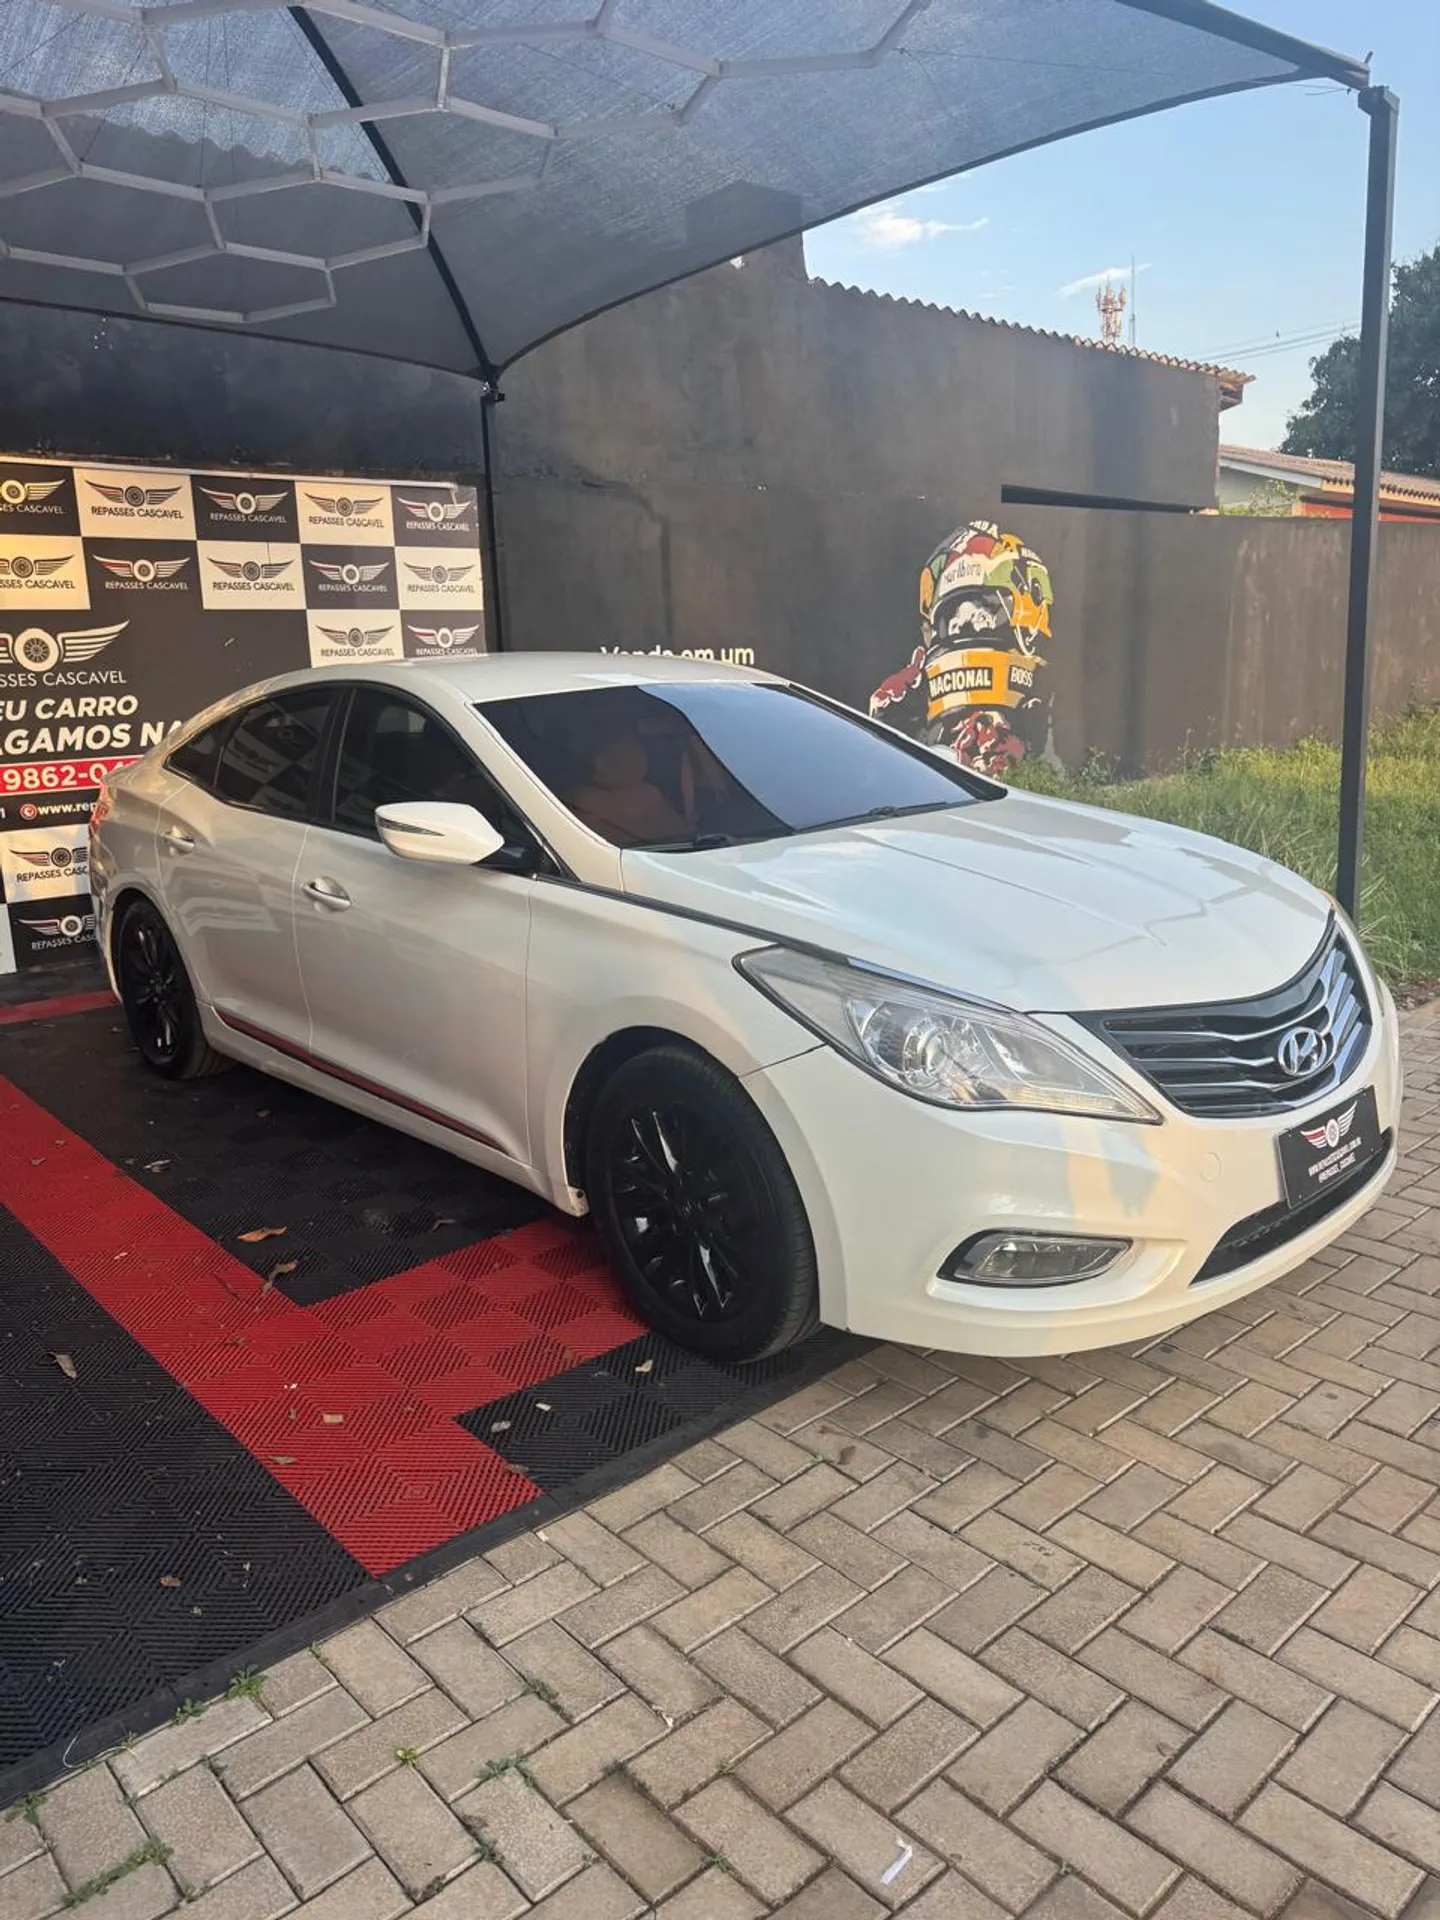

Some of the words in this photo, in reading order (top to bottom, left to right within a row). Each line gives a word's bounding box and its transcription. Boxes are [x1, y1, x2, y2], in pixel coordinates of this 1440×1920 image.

[16, 504, 66, 515] CASCAVEL
[91, 506, 135, 517] REPASSES
[137, 508, 184, 520] CASCAVEL
[209, 512, 246, 522] REPASSES
[247, 513, 288, 524] CASCAVEL
[308, 515, 345, 526] REPASSES
[346, 517, 385, 528] CASCAVEL
[25, 579, 76, 590] CASCAVEL
[105, 581, 145, 590] REPASSES
[146, 581, 189, 591] CASCAVEL
[212, 581, 252, 591] REPASSES
[253, 581, 295, 591] CASCAVEL
[320, 648, 357, 657] REPASSES
[357, 648, 396, 657] CASCAVEL
[721, 647, 755, 665] um
[42, 670, 127, 687] CASCAVEL
[929, 669, 992, 698] NACIONAL
[1010, 666, 1034, 688] BOSS
[35, 694, 138, 719] CARRO
[16, 869, 62, 882] REPASSES
[31, 937, 73, 951] REPASSES
